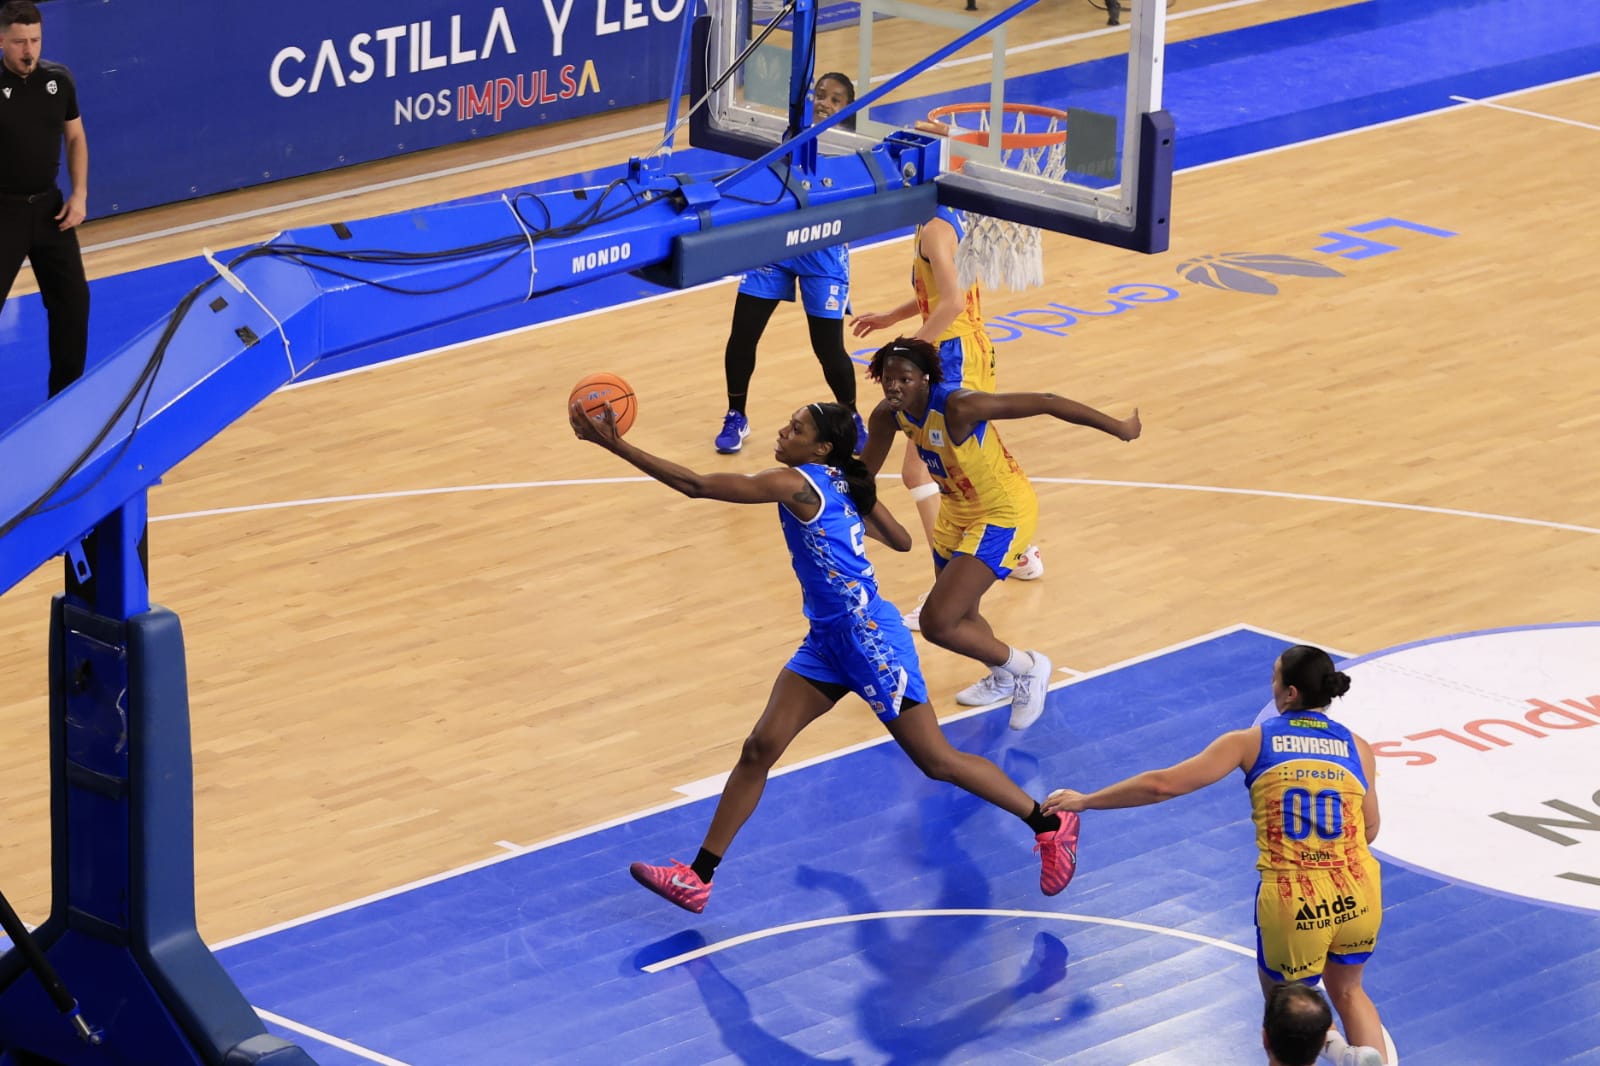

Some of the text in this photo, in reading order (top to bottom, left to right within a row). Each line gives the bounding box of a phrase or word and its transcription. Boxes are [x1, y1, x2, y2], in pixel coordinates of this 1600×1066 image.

[269, 7, 517, 98] CASTILLA
[542, 0, 574, 57] Y
[394, 60, 601, 126] NOS IMPULSA
[786, 219, 842, 247] MONDO
[1313, 217, 1460, 260] LF
[571, 242, 632, 274] MONDO
[1296, 768, 1345, 782] presbit
[1281, 787, 1344, 840] 00
